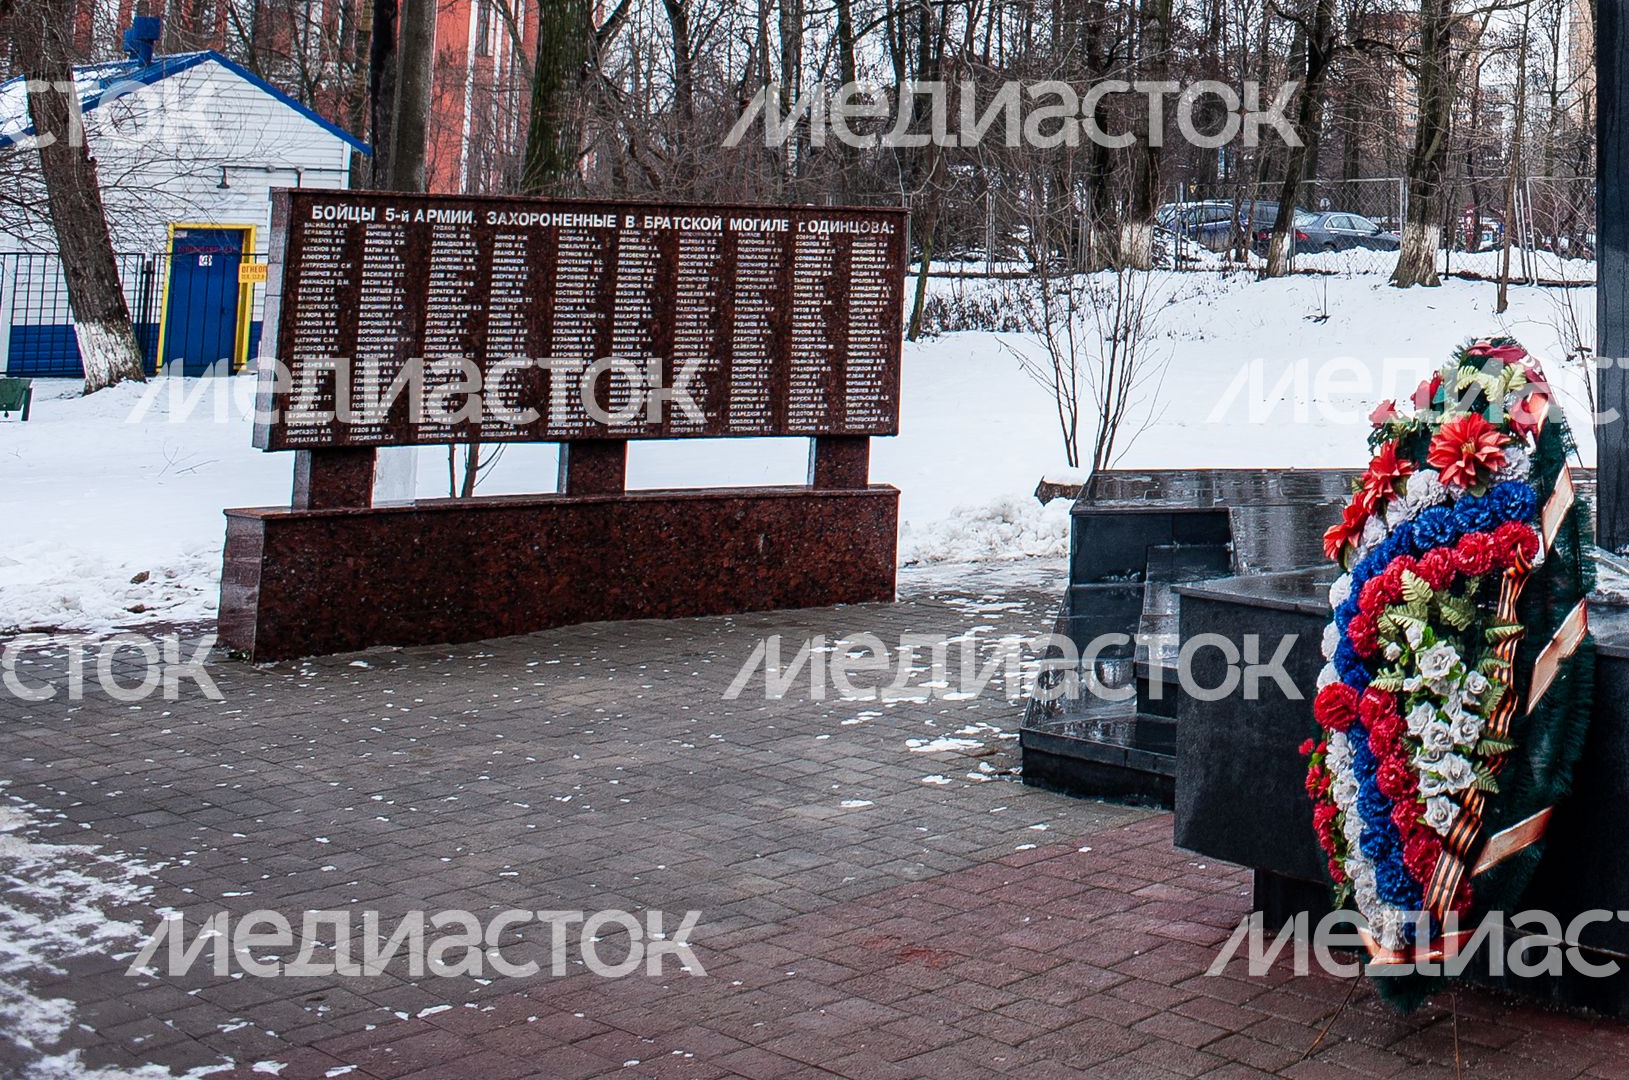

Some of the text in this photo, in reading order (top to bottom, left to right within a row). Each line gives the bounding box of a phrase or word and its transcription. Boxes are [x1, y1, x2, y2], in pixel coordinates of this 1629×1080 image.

[312, 204, 375, 223] БОЙЦЫ
[385, 208, 409, 221] 5-й
[486, 211, 617, 228] ЗАХОРОНЕННЫЕ
[625, 215, 635, 228] В
[644, 215, 722, 230] БРАТСКОЙ
[729, 219, 789, 231] МОГИЛЕ
